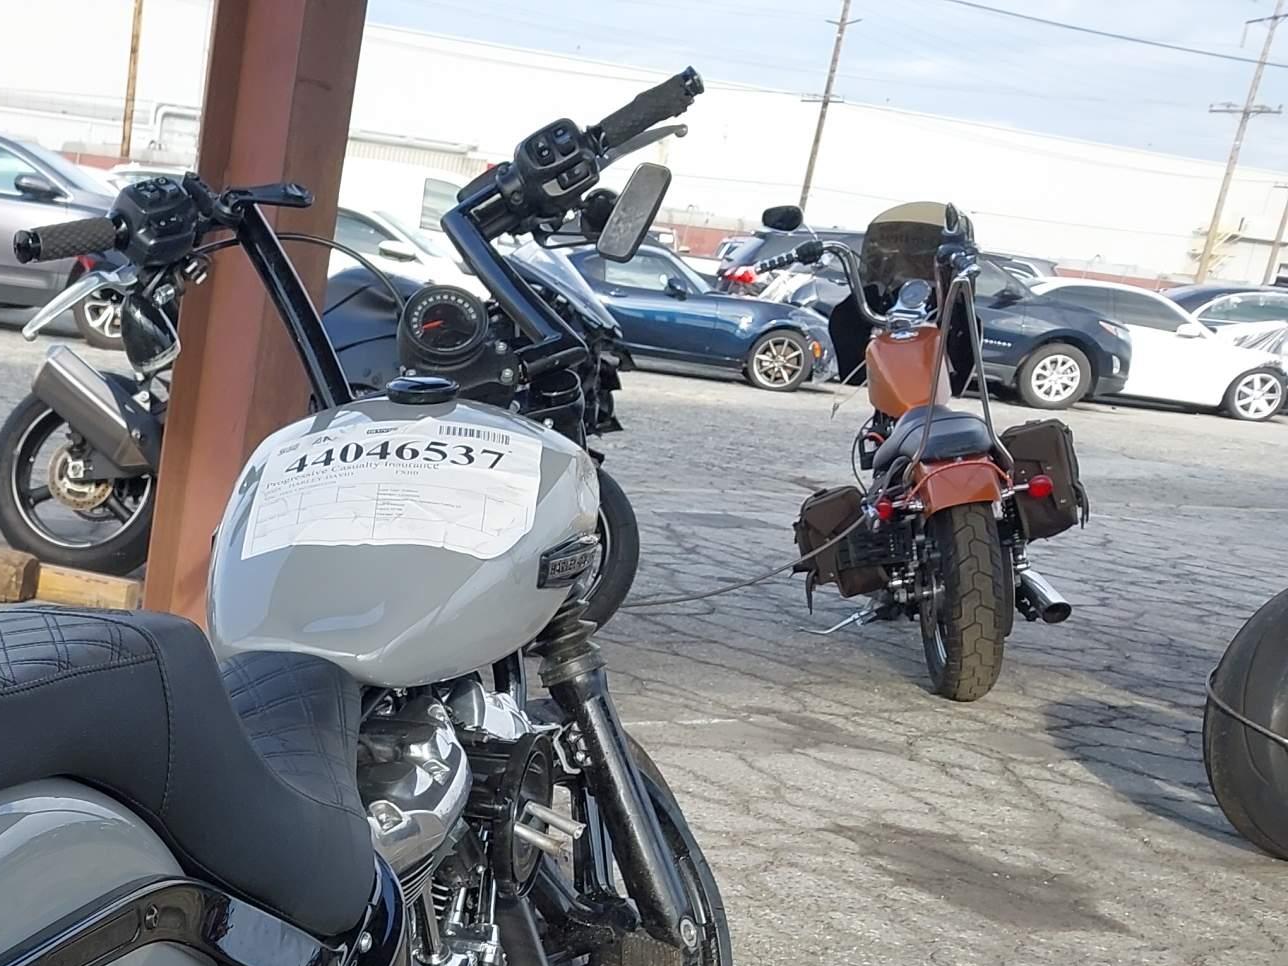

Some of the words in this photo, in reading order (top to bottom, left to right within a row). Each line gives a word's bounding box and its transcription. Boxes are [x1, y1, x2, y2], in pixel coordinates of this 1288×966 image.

[285, 440, 505, 473] 44046537
[266, 466, 329, 488] Progressive
[331, 462, 378, 472] Casualty
[384, 460, 440, 470] Insurance
